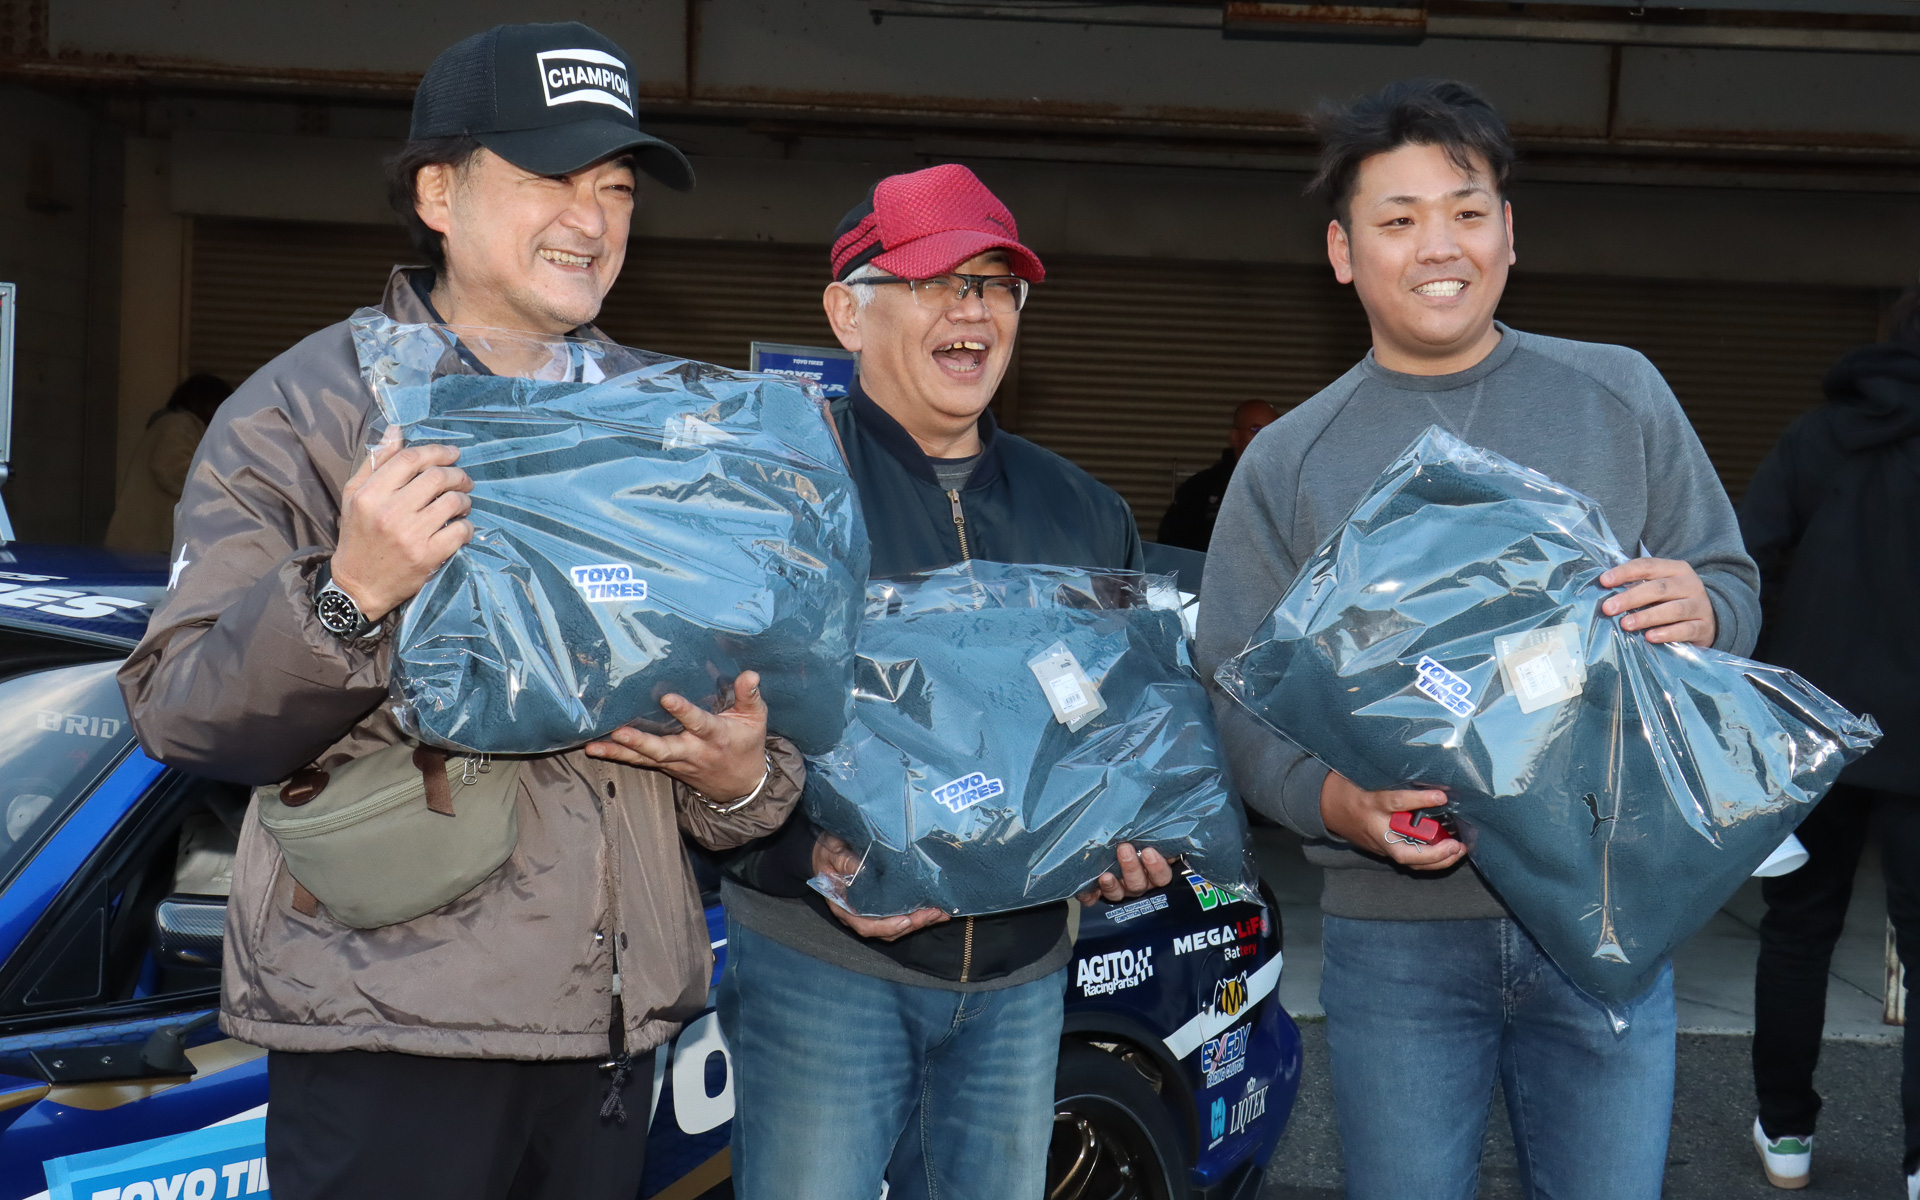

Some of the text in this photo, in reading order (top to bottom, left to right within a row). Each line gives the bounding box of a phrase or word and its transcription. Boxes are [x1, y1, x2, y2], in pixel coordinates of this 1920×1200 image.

[548, 65, 631, 99] CHAMPION
[792, 358, 824, 367] TOYO TIRES
[574, 567, 630, 583] TOYO
[587, 583, 645, 599] TIRES
[1420, 658, 1468, 696] TOYO
[1419, 675, 1472, 715] TIRES
[37, 709, 125, 739] BRID
[934, 774, 984, 802] TOYO
[949, 781, 1001, 811] TIRES
[1224, 943, 1257, 961] Battery
[1076, 948, 1135, 988] AGITO
[1201, 1022, 1252, 1073] EXEDY
[1229, 1085, 1269, 1134] LIQTEK
